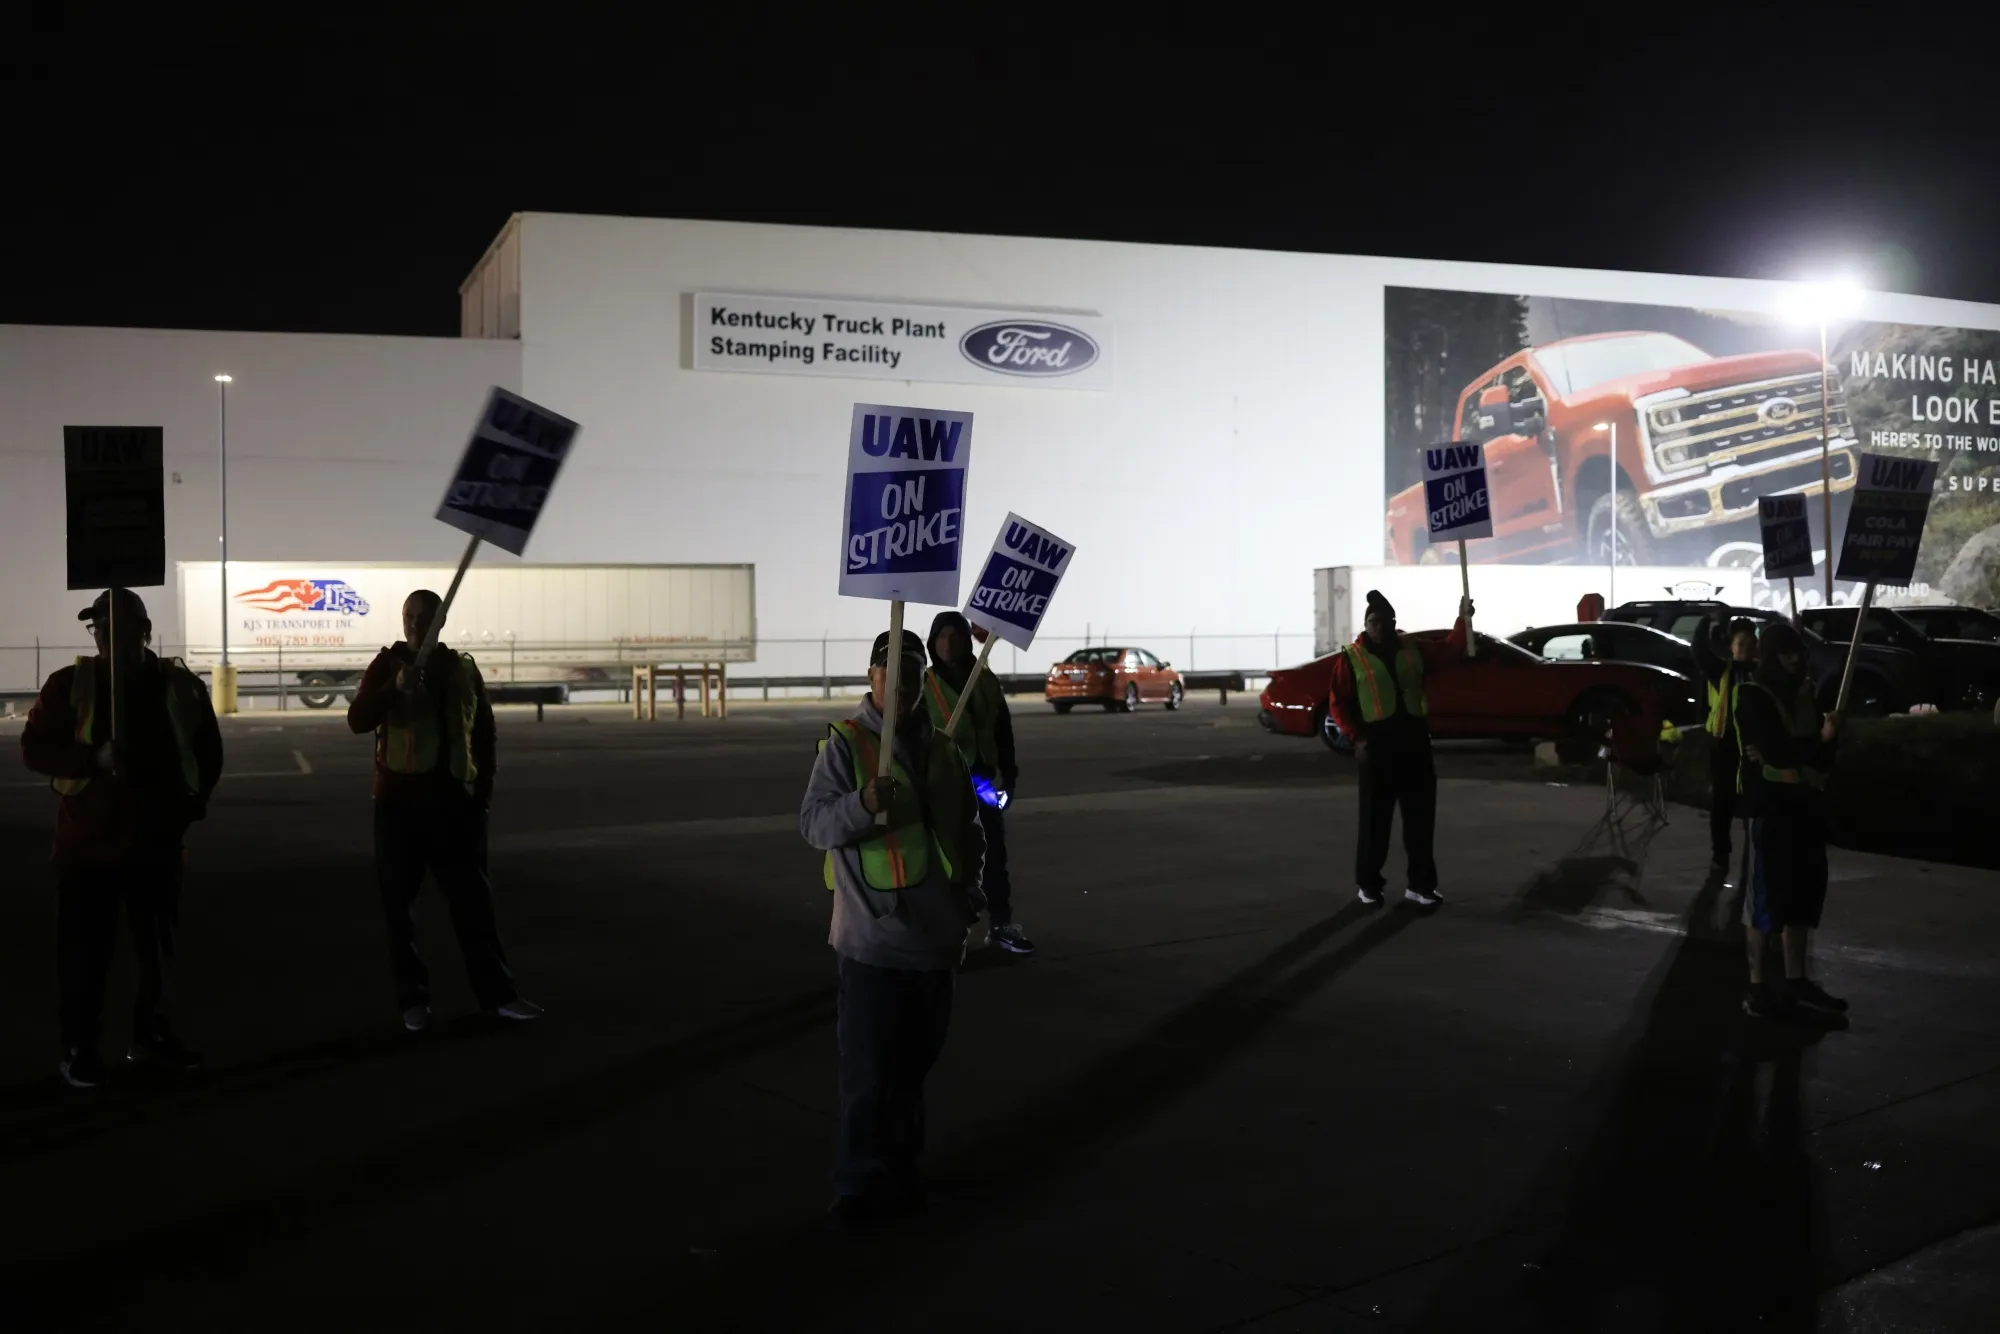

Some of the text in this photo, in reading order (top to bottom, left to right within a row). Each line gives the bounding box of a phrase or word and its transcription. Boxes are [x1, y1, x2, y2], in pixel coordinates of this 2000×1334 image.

[711, 307, 946, 338] Kentucky Truck Plant
[711, 337, 901, 369] Stamping Facility
[988, 328, 1072, 367] Ford
[1851, 351, 1997, 385] MAKING HA
[1912, 395, 1979, 424] LOOK
[862, 414, 963, 462] UAW
[1871, 431, 2000, 452] HERE'S TO THE WO
[1427, 445, 1479, 471] UAW
[1443, 475, 1467, 501] ON
[1871, 459, 1926, 490] UAW
[1949, 475, 2000, 492] SUPE
[881, 476, 926, 519] ON
[1431, 488, 1487, 530] STRIKE
[1763, 499, 1802, 519] UAW
[849, 507, 960, 569] STRIKE
[1865, 516, 1906, 530] COLA
[1004, 521, 1067, 571] UAW
[1848, 533, 1920, 549] FAIR PAY
[1001, 566, 1034, 590] ON
[1876, 582, 1929, 598] PROUD
[972, 585, 1048, 616] STRIKE
[243, 620, 262, 632] KJS
[267, 619, 332, 630] TRANSPORT
